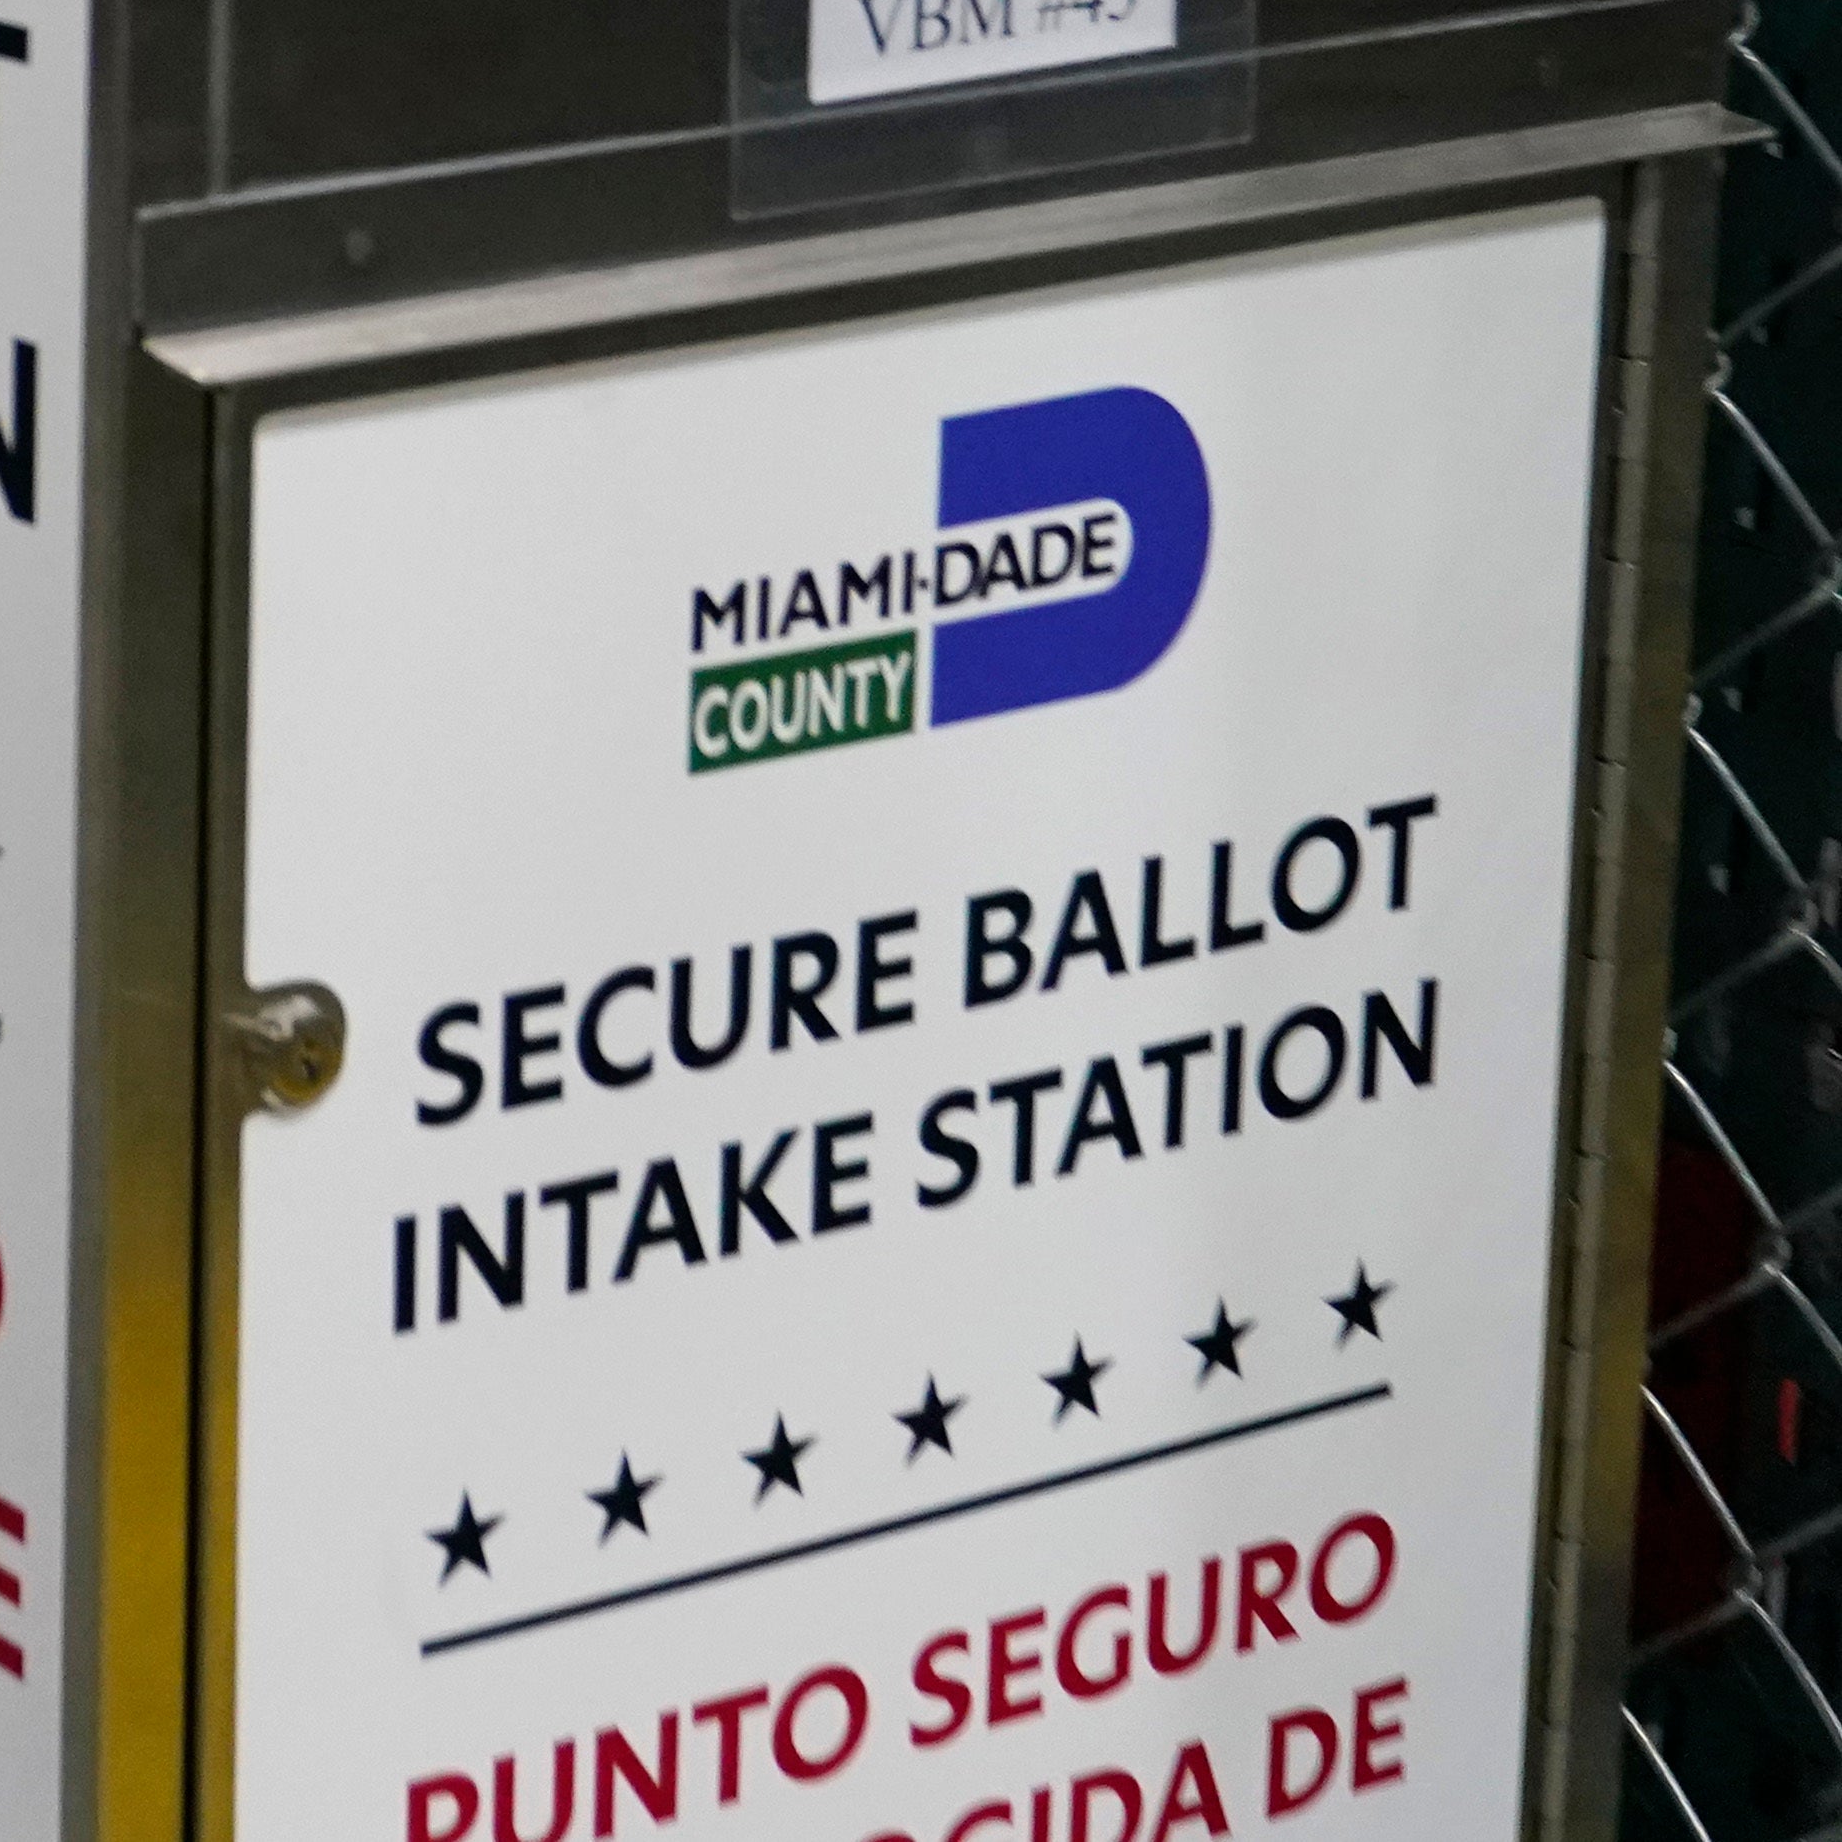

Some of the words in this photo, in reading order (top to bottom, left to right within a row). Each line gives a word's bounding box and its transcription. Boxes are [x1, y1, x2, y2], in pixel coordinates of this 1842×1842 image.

[689, 512, 1118, 652] MIAMI-DADE
[693, 654, 911, 758] COUNTY
[417, 910, 917, 1127] SECURE
[964, 795, 1437, 1008] BALLOT
[394, 1113, 873, 1333] INTAKE
[918, 978, 1438, 1208] STATION
[407, 1666, 868, 1842] PUNTO
[911, 1513, 1396, 1747] SEGURO
[1267, 1678, 1407, 1818] DE
